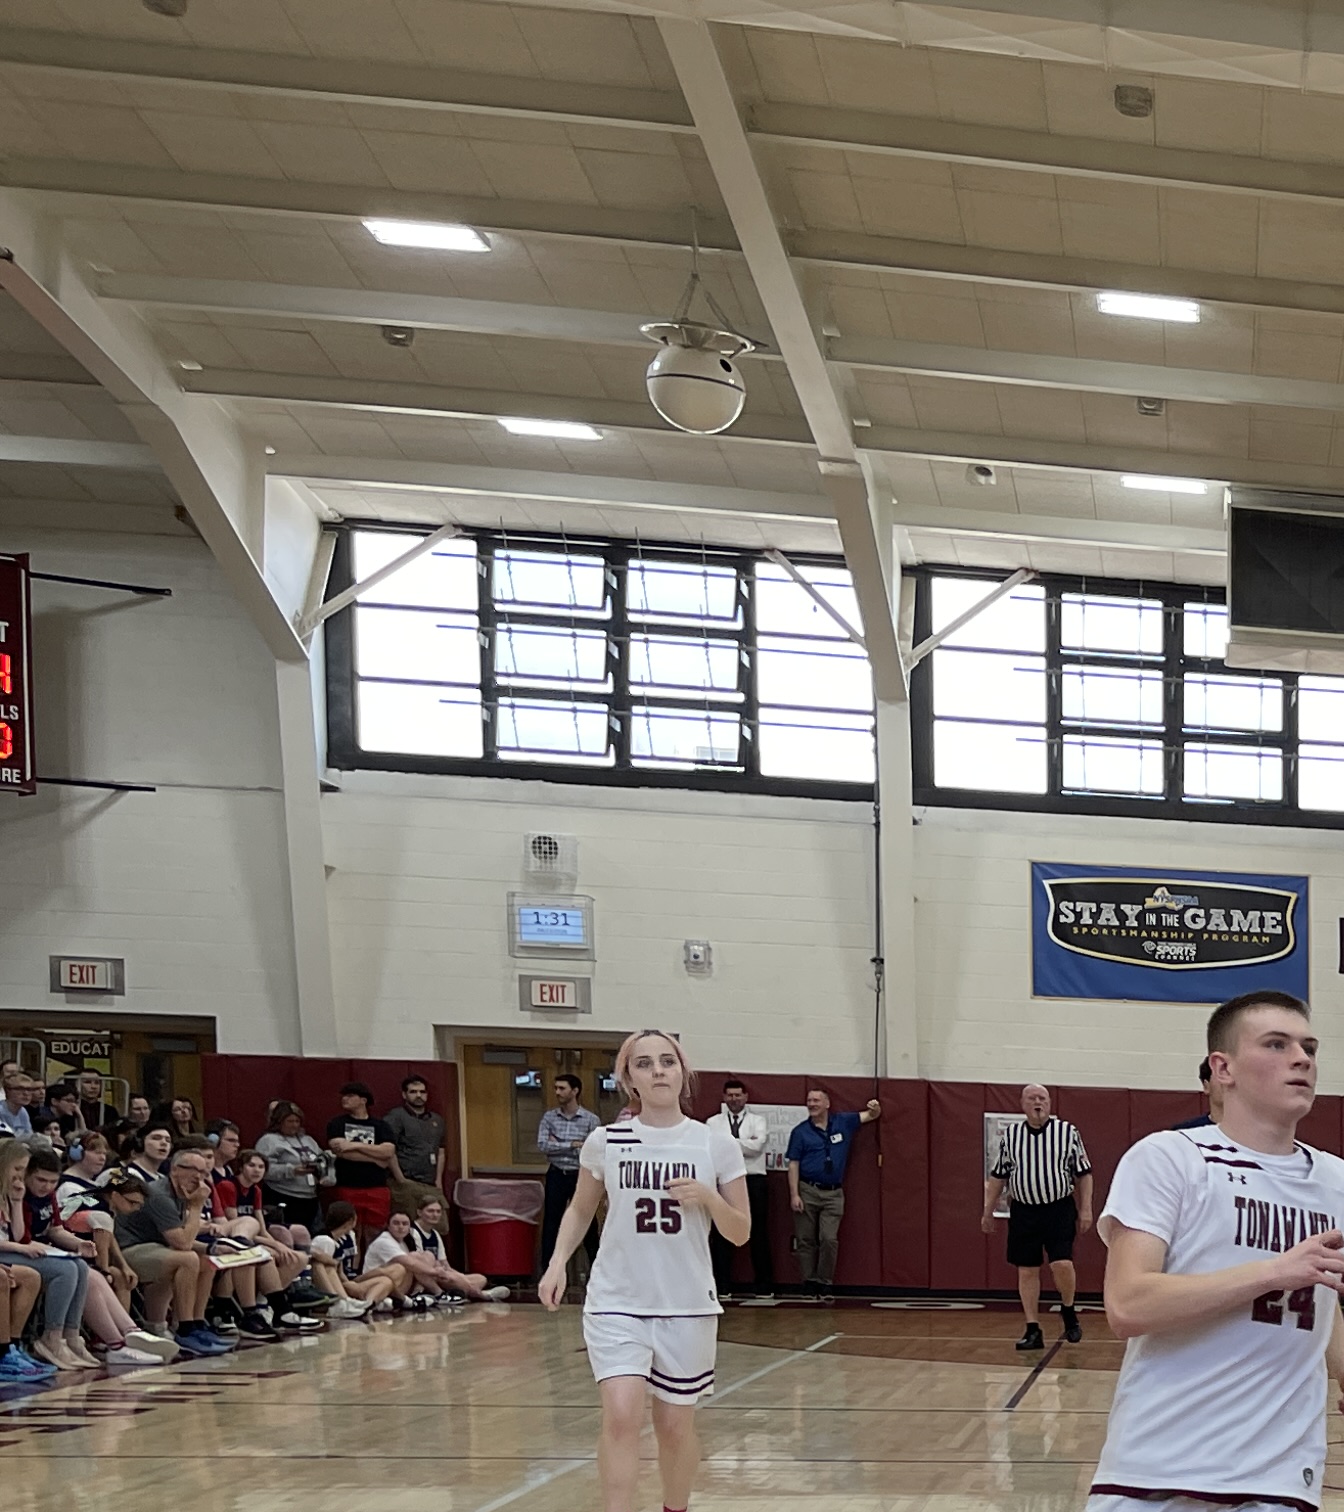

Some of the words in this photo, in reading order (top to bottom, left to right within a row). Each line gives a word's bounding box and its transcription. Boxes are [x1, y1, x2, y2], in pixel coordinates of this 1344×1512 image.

[533, 911, 570, 927] 1:31
[1059, 901, 1143, 927] STAY
[1145, 912, 1157, 926] IN
[1161, 913, 1180, 927] THE
[1184, 908, 1282, 934] GAME
[1072, 926, 1195, 940] SPORTSMANSHIP
[1203, 932, 1271, 944] PROGRAM
[1156, 945, 1197, 957] SPORTS
[69, 964, 98, 985] EXIT
[539, 983, 567, 1004] EXIT
[51, 1041, 112, 1056] EDUCAT
[635, 1198, 682, 1234] 25
